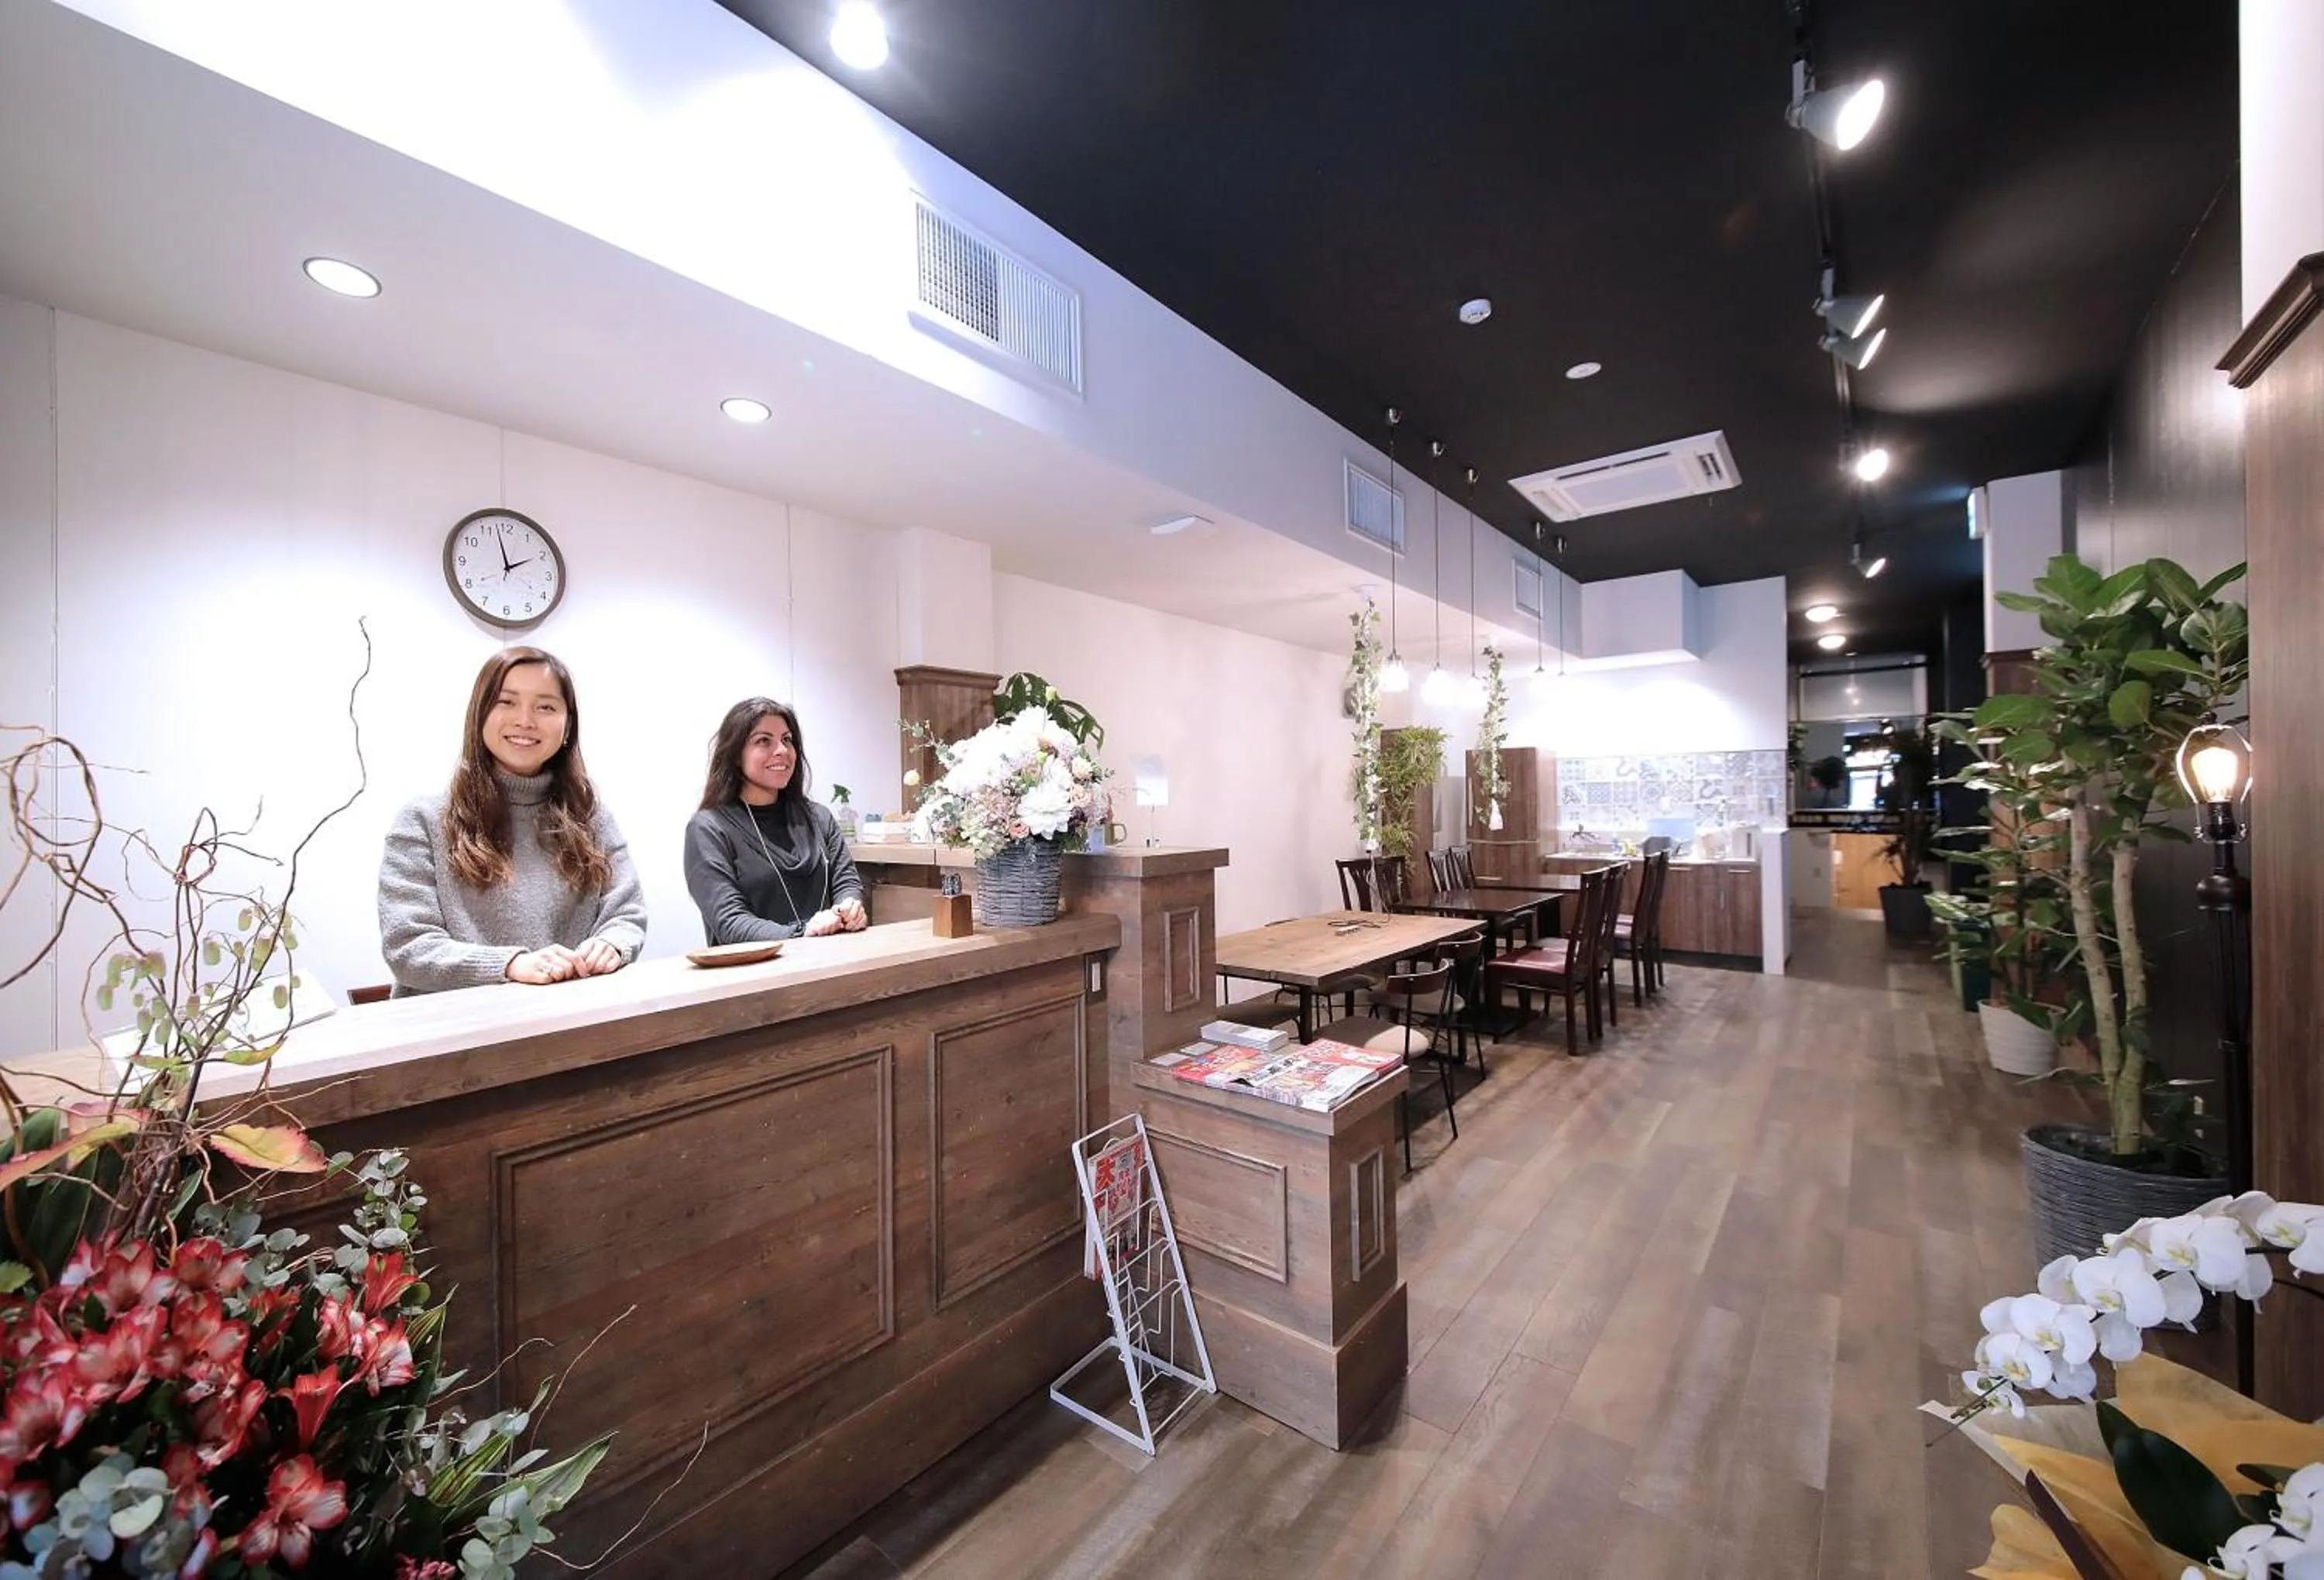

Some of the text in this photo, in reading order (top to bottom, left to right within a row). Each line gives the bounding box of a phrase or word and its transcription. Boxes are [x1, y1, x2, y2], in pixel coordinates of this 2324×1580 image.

[480, 524, 492, 536] 11
[500, 523, 514, 535] 12
[464, 536, 478, 548] 10
[524, 534, 530, 543] 1
[458, 555, 466, 566] 9
[538, 551, 546, 562] 2
[545, 571, 552, 582] 3
[464, 579, 473, 589] 8
[482, 596, 489, 606] 7
[540, 591, 546, 601] 4
[503, 605, 511, 616] 6
[524, 603, 532, 613] 5
